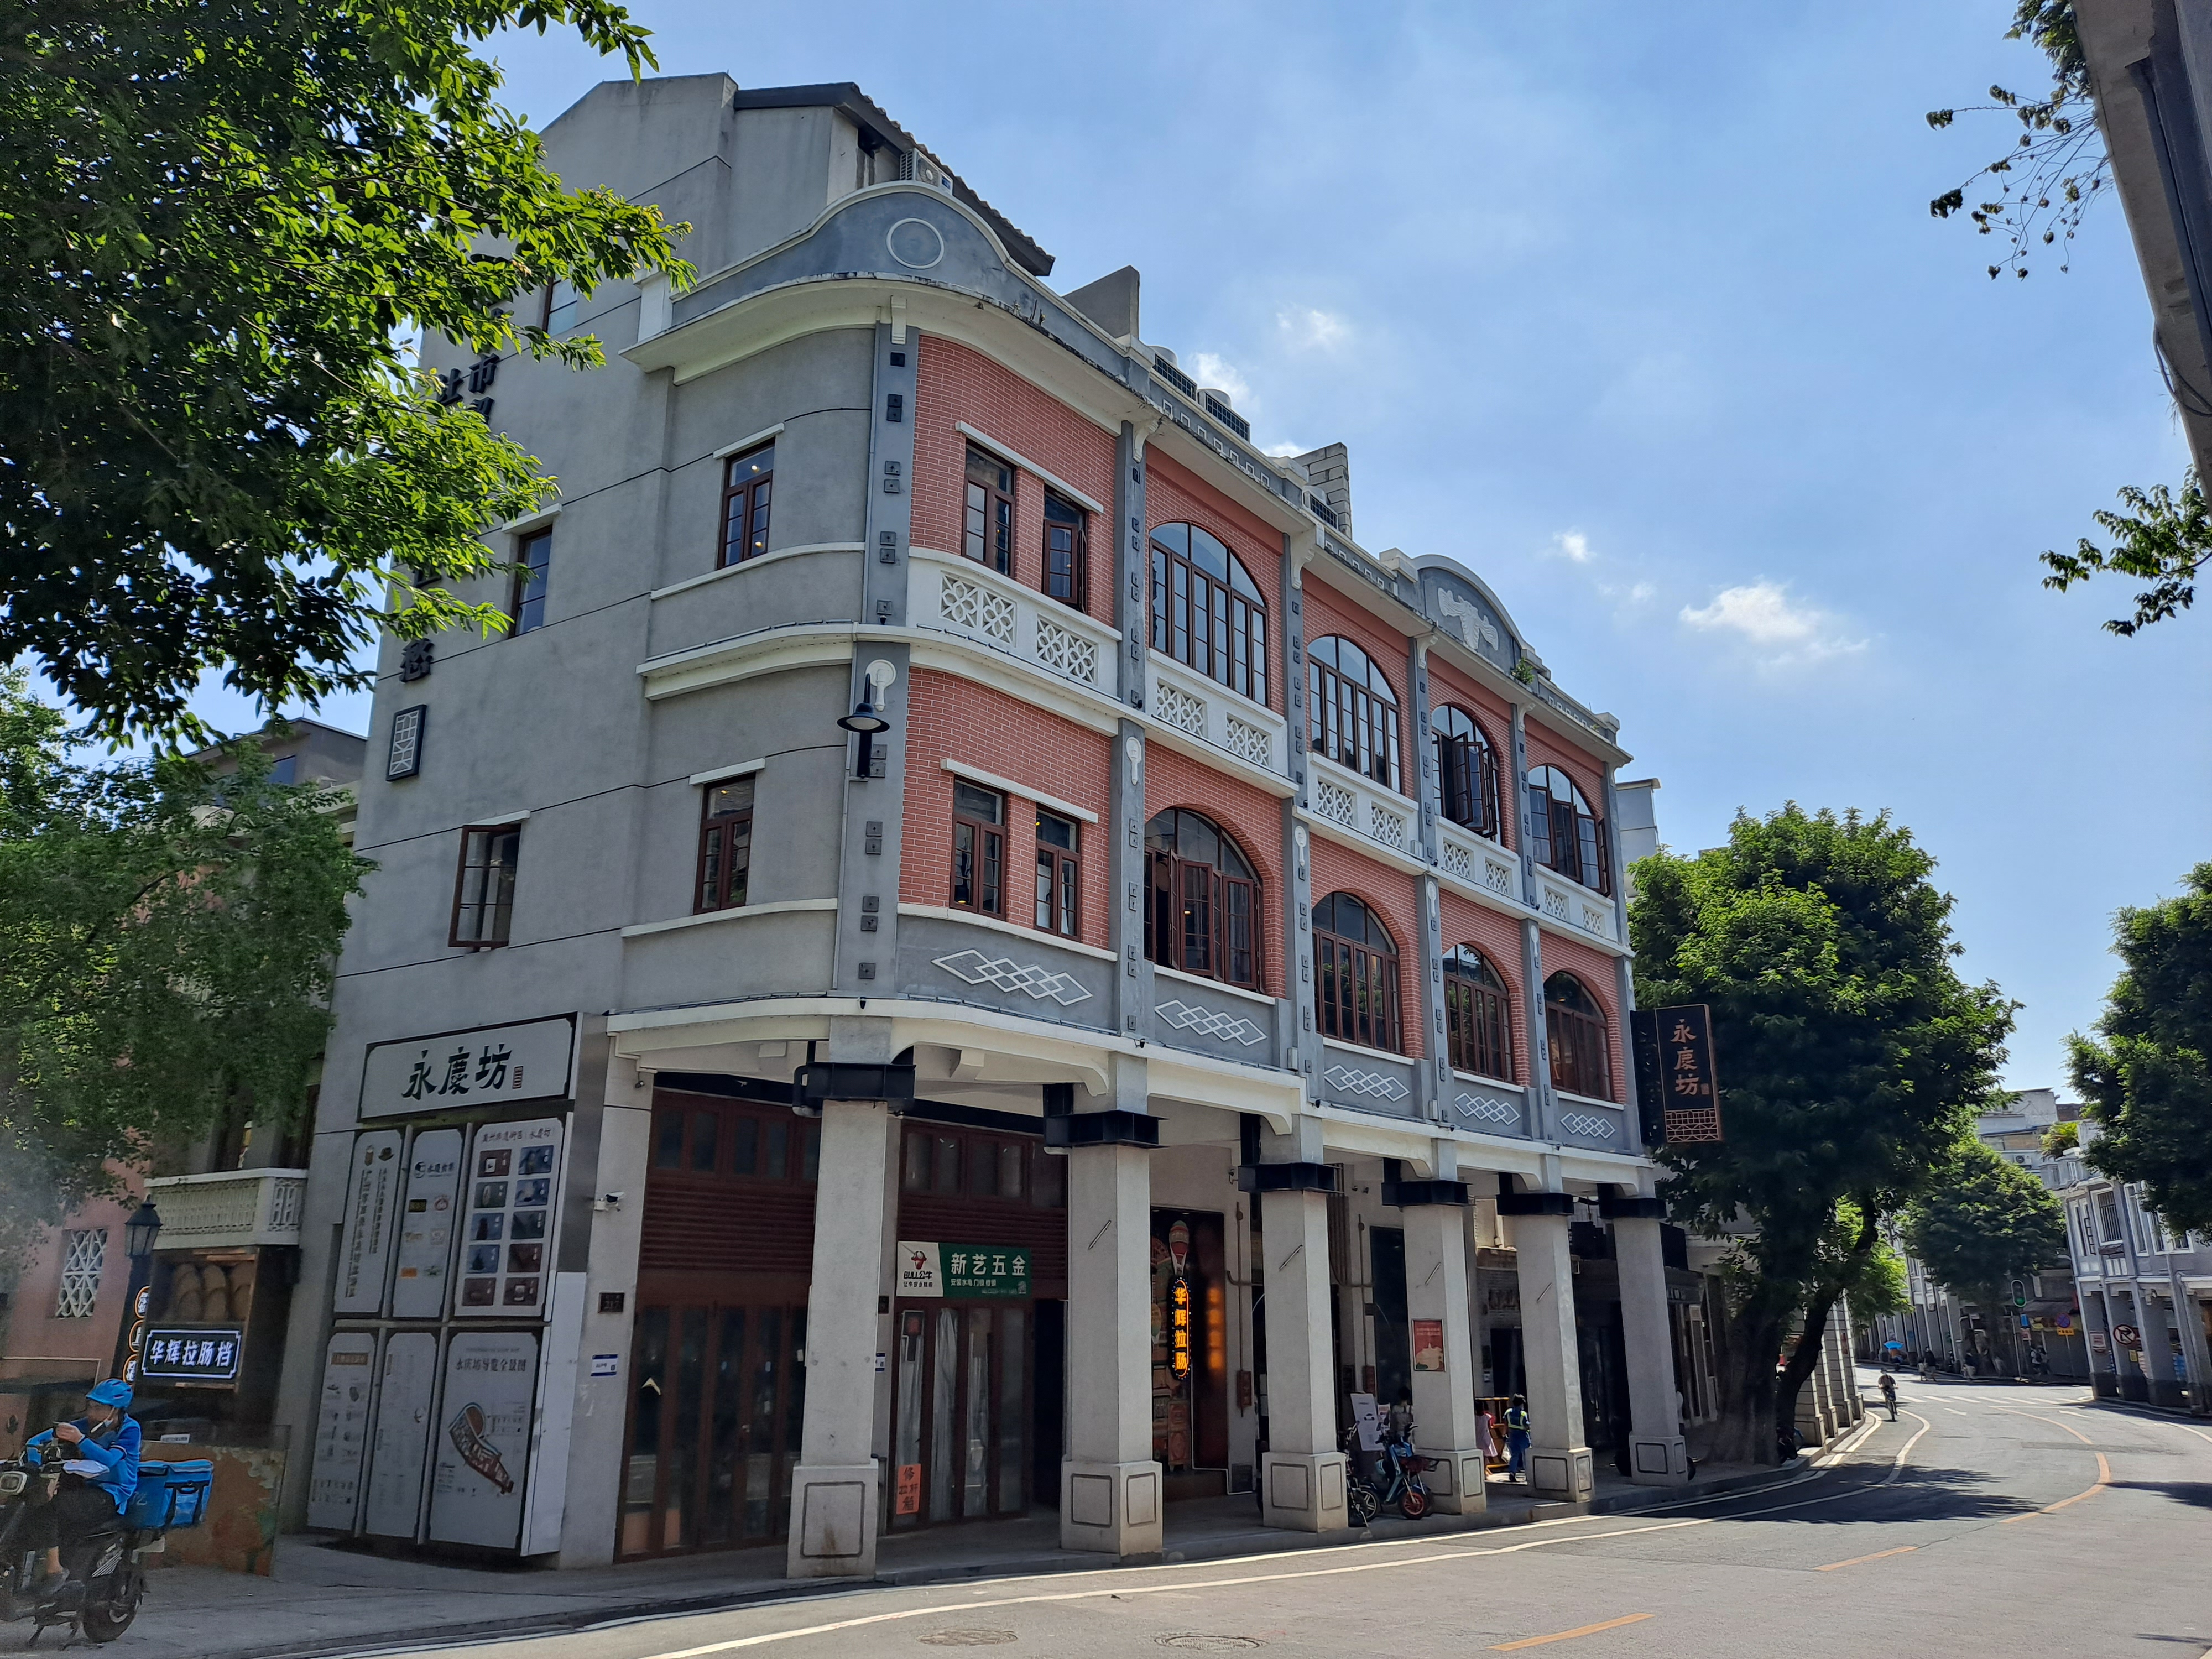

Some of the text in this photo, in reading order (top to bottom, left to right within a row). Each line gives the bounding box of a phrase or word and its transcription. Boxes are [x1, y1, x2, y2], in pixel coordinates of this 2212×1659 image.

[951, 1252, 1026, 1276] 新艺五金
[1173, 1287, 1187, 1370] 华辉拉肠
[150, 1339, 234, 1367] 华辉拉肠档
